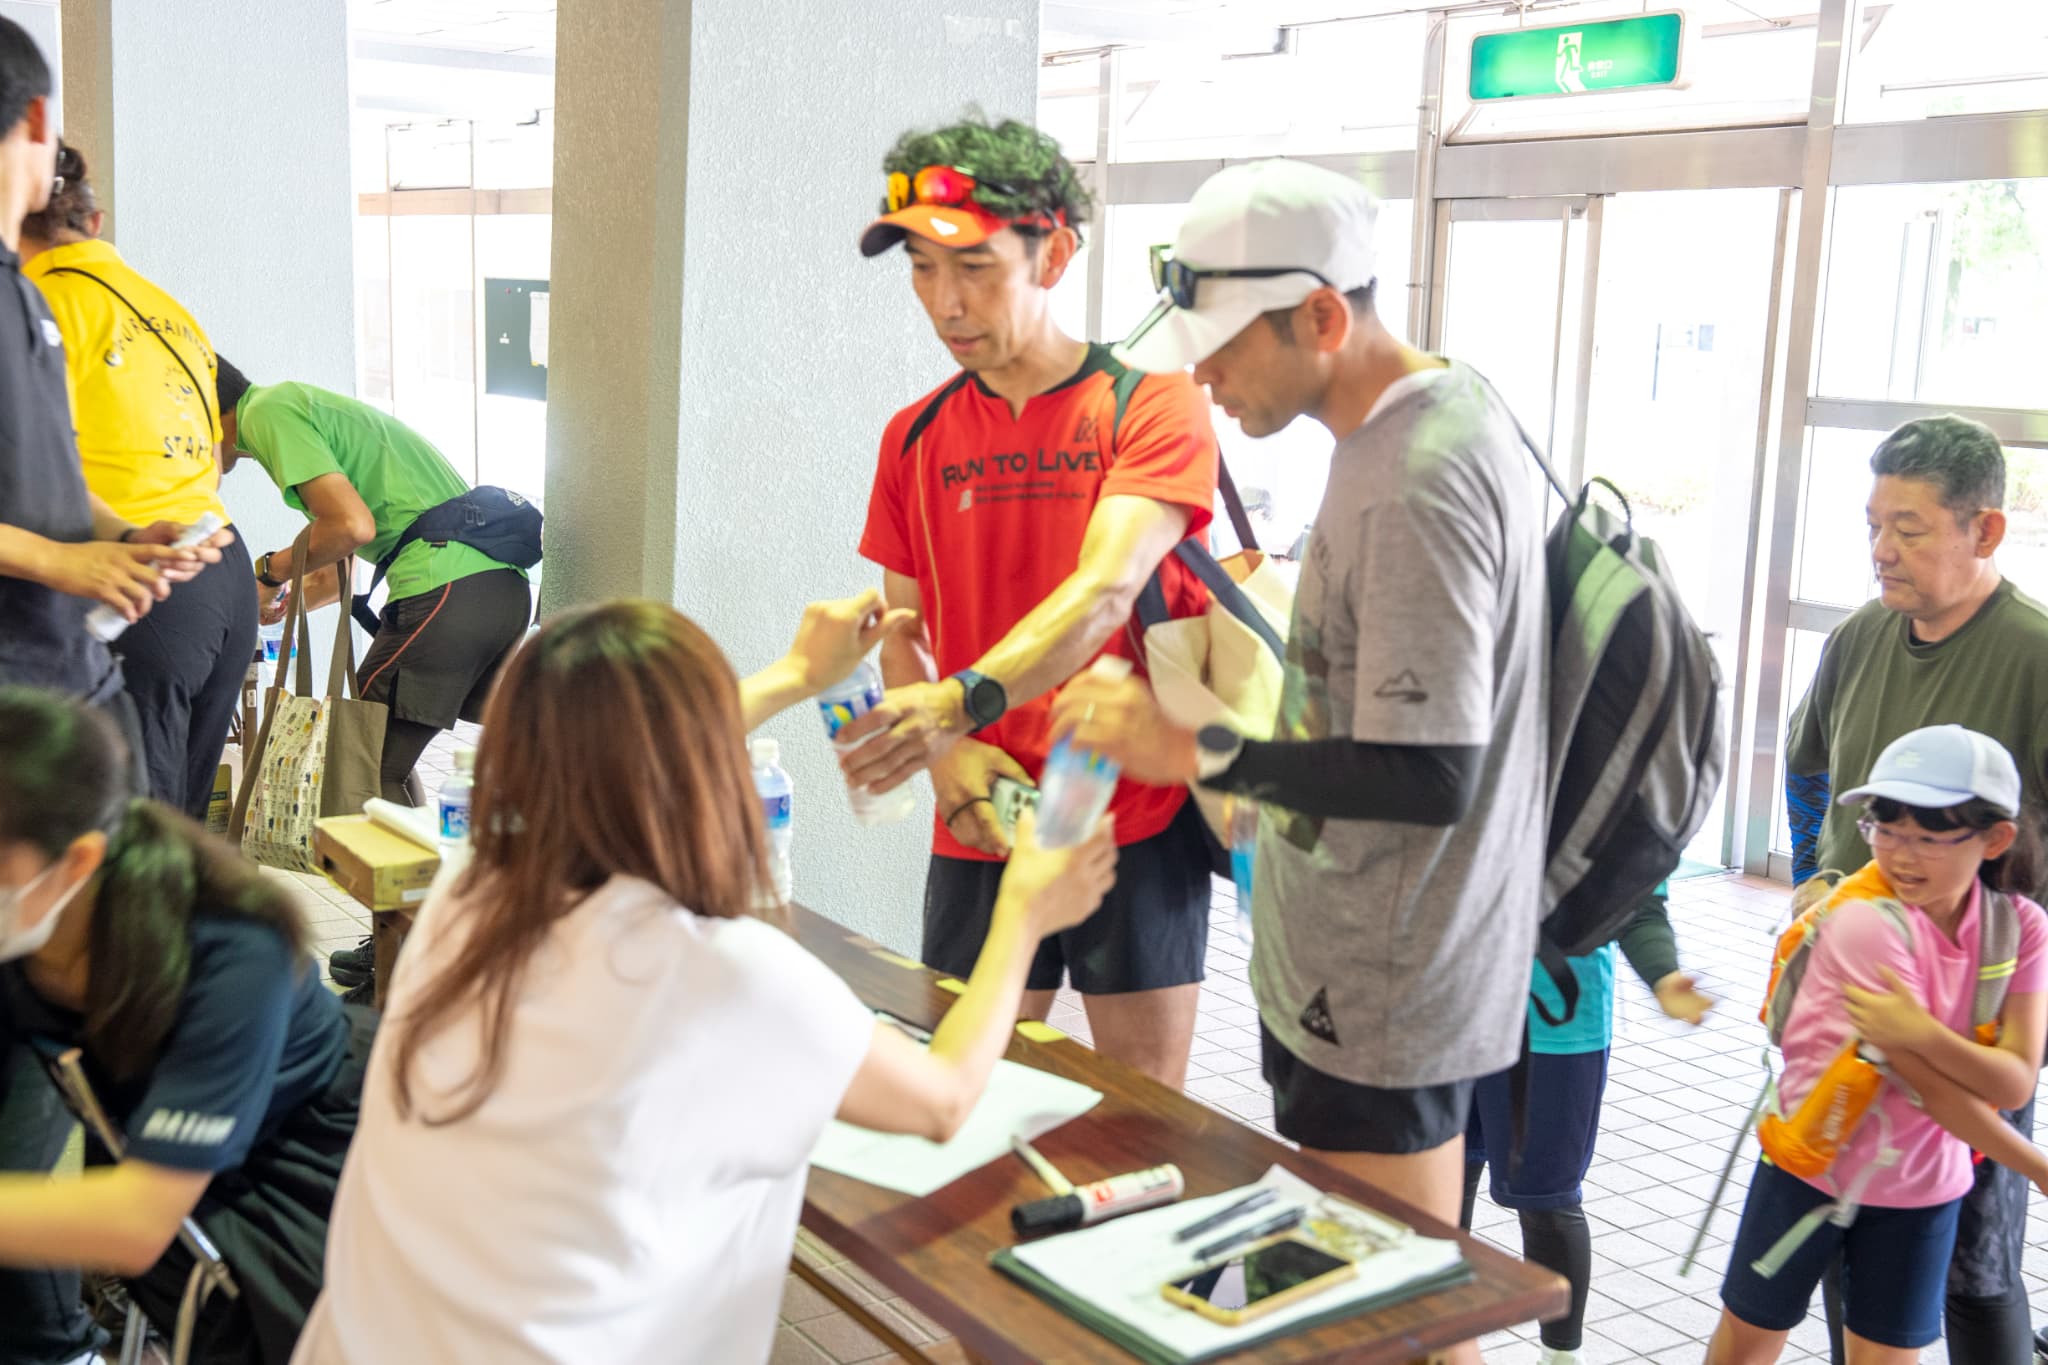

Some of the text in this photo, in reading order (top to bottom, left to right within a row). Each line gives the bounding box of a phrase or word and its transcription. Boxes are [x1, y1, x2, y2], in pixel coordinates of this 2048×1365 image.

[942, 457, 985, 489] RUN
[992, 452, 1028, 475] TO
[1037, 448, 1100, 472] LIVE
